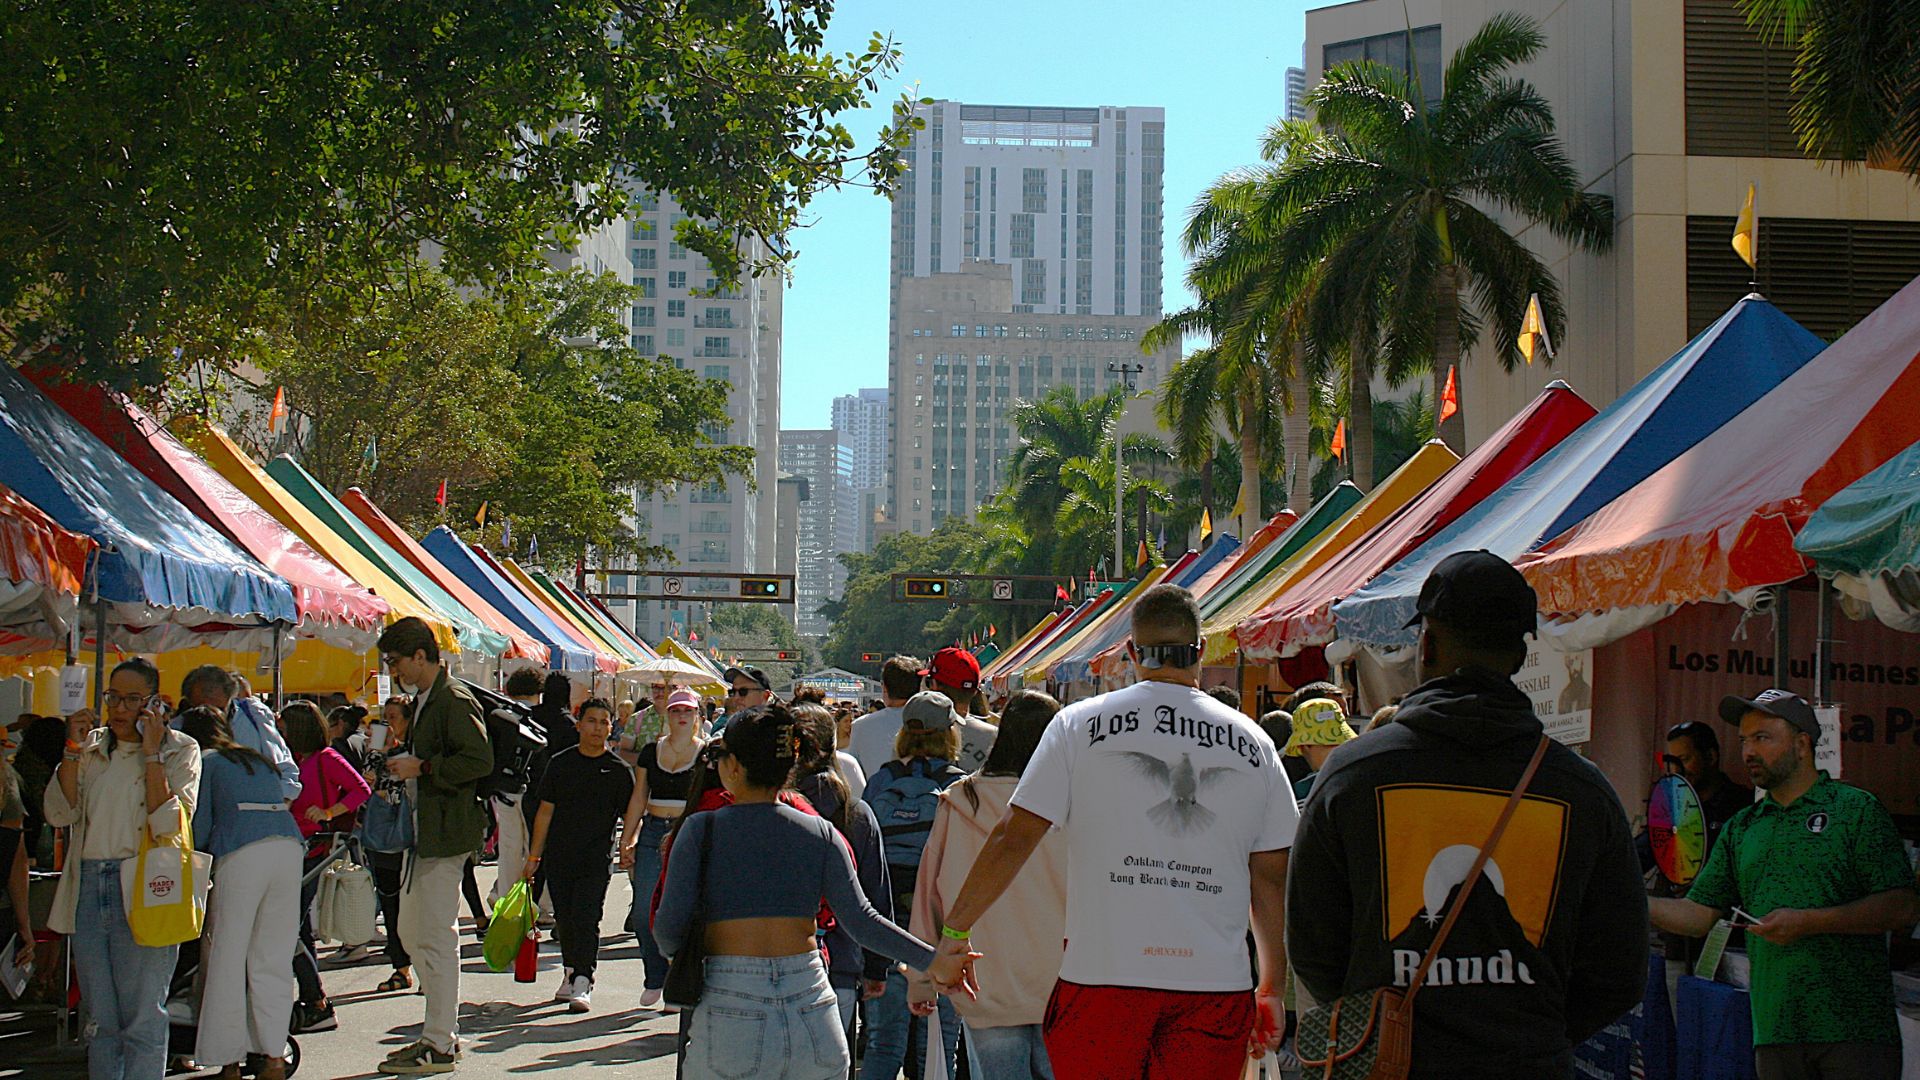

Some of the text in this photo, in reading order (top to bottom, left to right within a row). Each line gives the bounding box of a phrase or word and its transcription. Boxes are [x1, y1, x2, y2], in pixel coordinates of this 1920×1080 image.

[1669, 645, 1919, 686] Los Muulmanes
[1516, 675, 1550, 693] ESSIAH
[1533, 700, 1553, 717] OME
[1086, 704, 1260, 768] Los Angeles
[1168, 860, 1212, 875] Compton
[1109, 871, 1134, 886] Long
[1170, 877, 1190, 889] San
[1196, 881, 1223, 895] Diego
